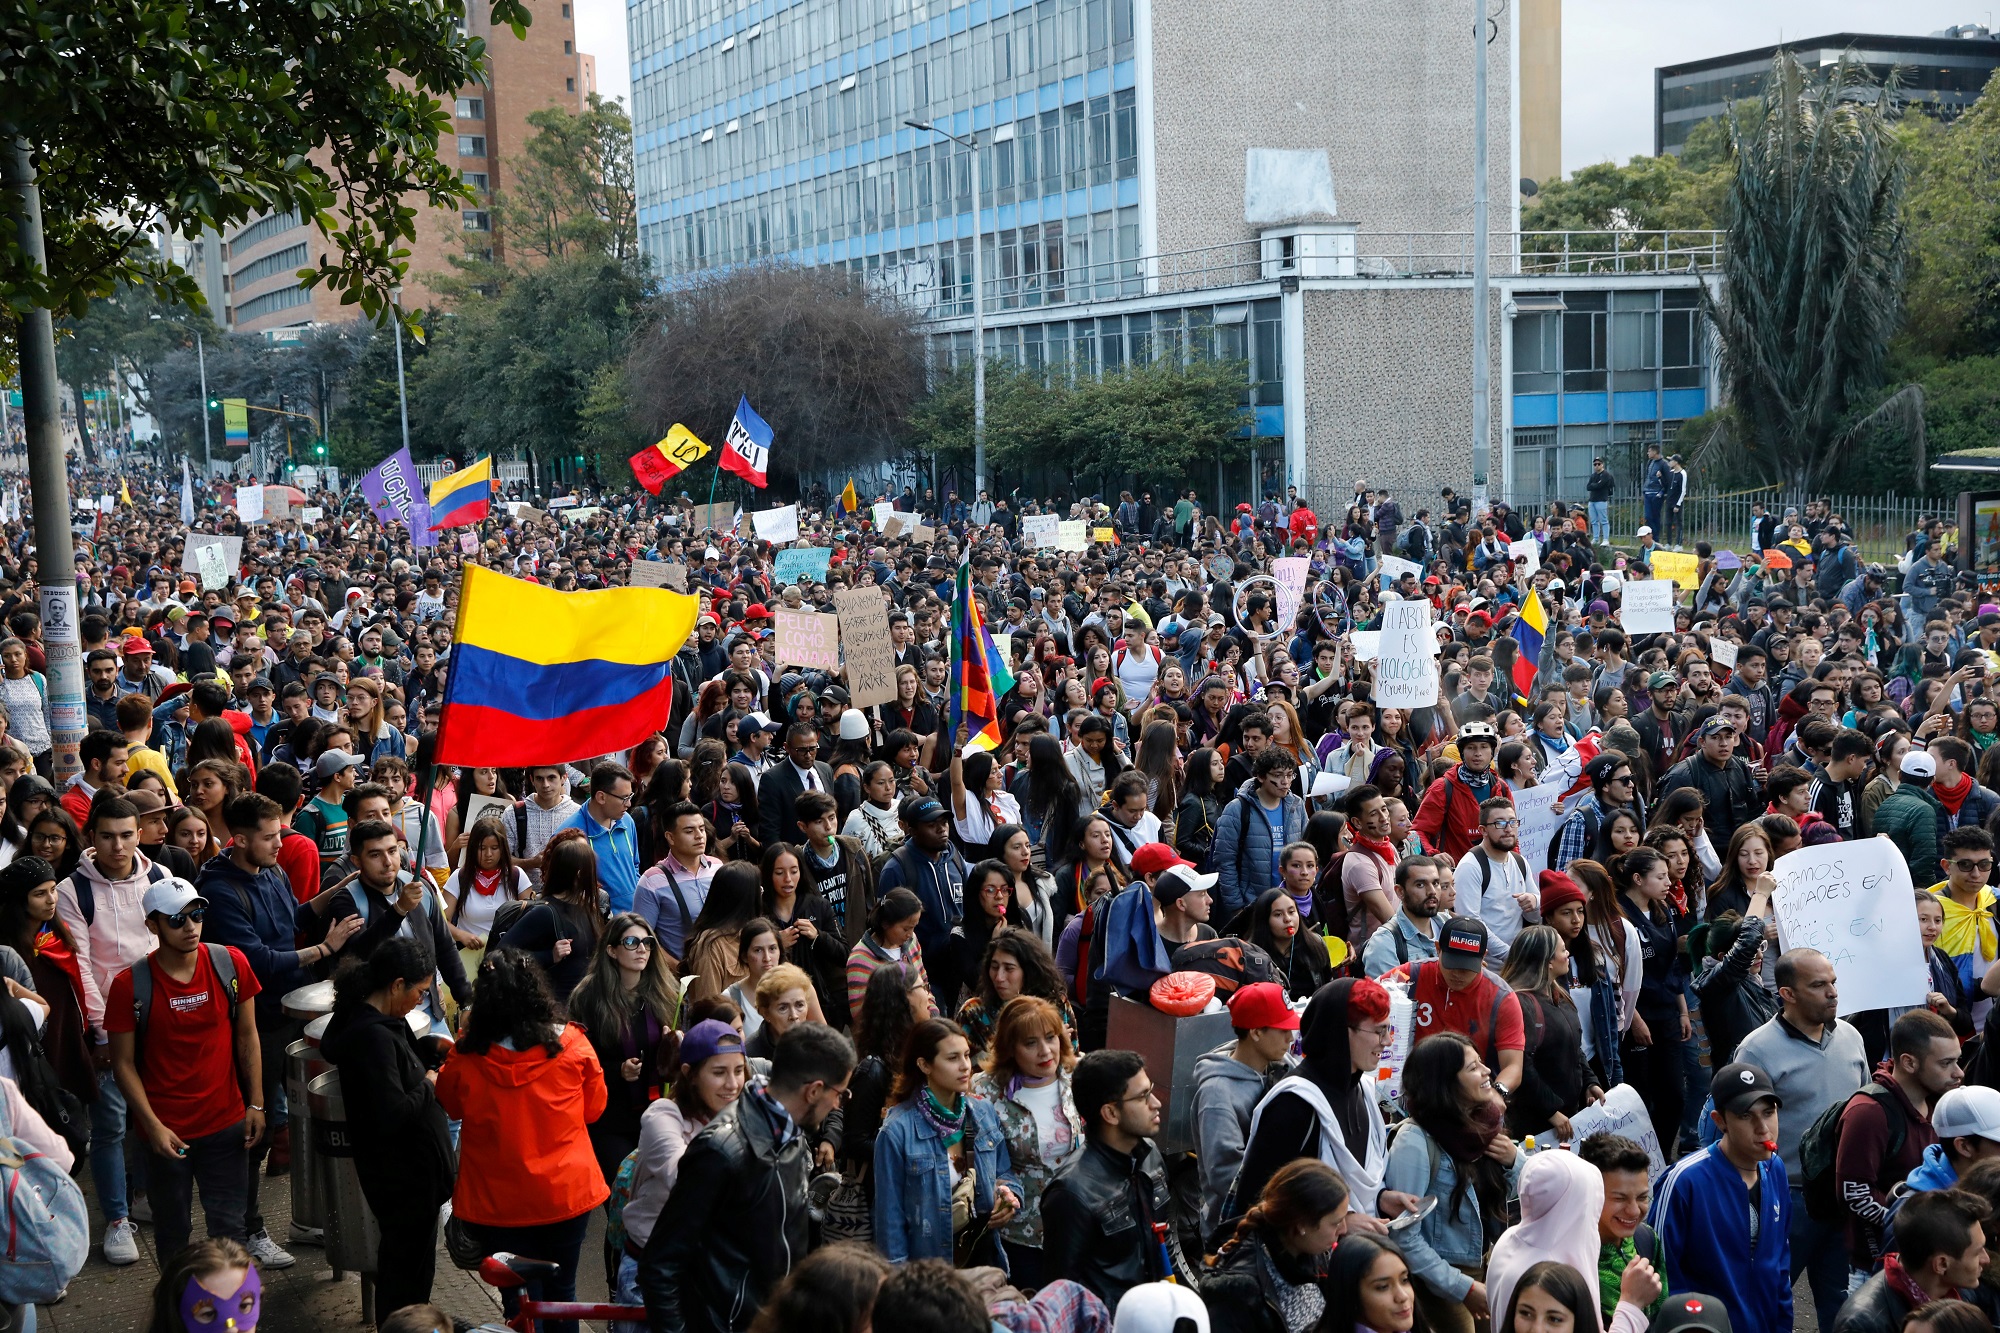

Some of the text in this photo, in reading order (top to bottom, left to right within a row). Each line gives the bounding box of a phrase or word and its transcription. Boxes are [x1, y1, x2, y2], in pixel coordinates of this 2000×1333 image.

[776, 612, 825, 633] PELEA
[785, 630, 825, 648] COMO
[1403, 633, 1418, 654] ES
[1538, 822, 1552, 837] que
[1519, 839, 1535, 852] aga
[1862, 868, 1893, 890] EN
[1849, 917, 1883, 937] EN
[1450, 935, 1481, 947] HILFIGER
[172, 994, 207, 1006] SINNERS
